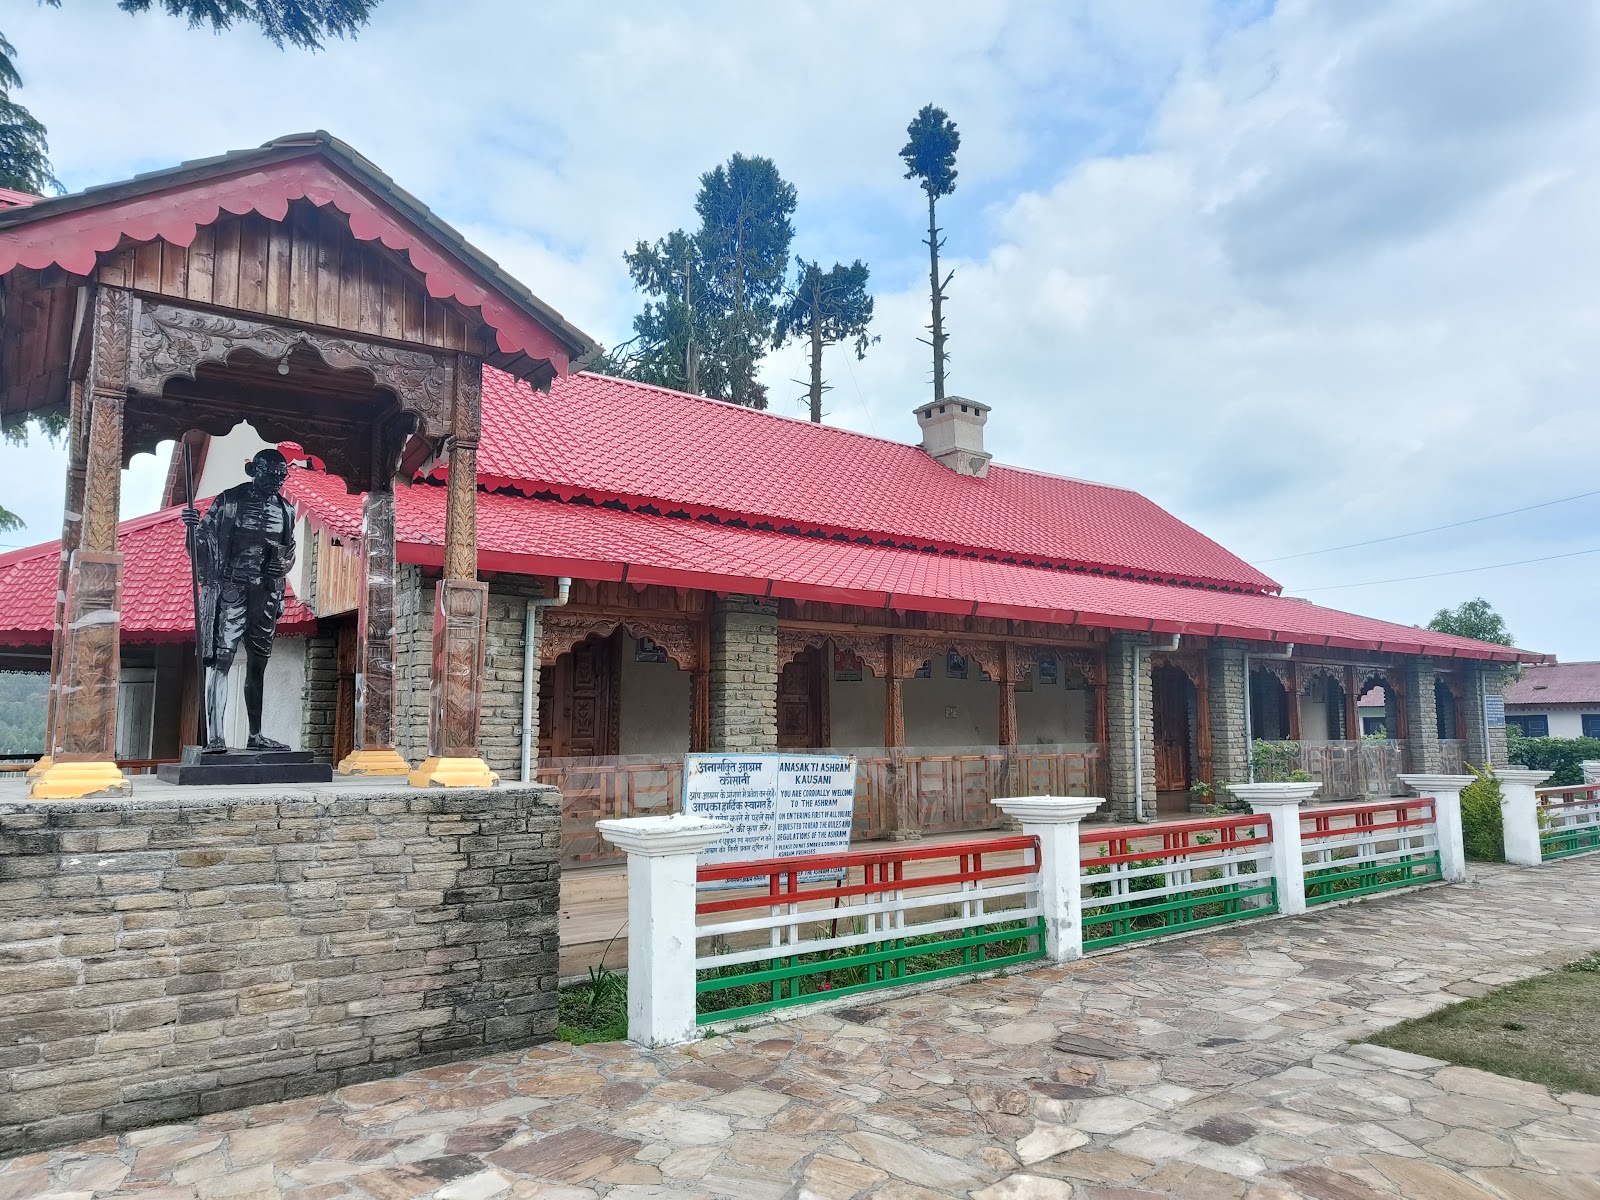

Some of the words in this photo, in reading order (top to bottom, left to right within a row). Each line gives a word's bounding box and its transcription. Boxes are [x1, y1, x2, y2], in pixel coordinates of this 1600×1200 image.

[697, 758, 737, 773] अनासक्ति
[738, 762, 762, 772] आश्रम
[820, 763, 850, 772] ASHRAM
[719, 773, 750, 786] कौसानी
[796, 775, 831, 784] KAUSANI
[689, 792, 701, 800] आप
[702, 792, 719, 800] आश्रम
[691, 802, 721, 812] आपका
[722, 798, 743, 813] हार्दिक
[744, 801, 766, 810] स्वागत
[814, 799, 838, 807] ASHRAM
[778, 823, 801, 831] REQUESTED
[777, 832, 810, 841] REGULATIONS
